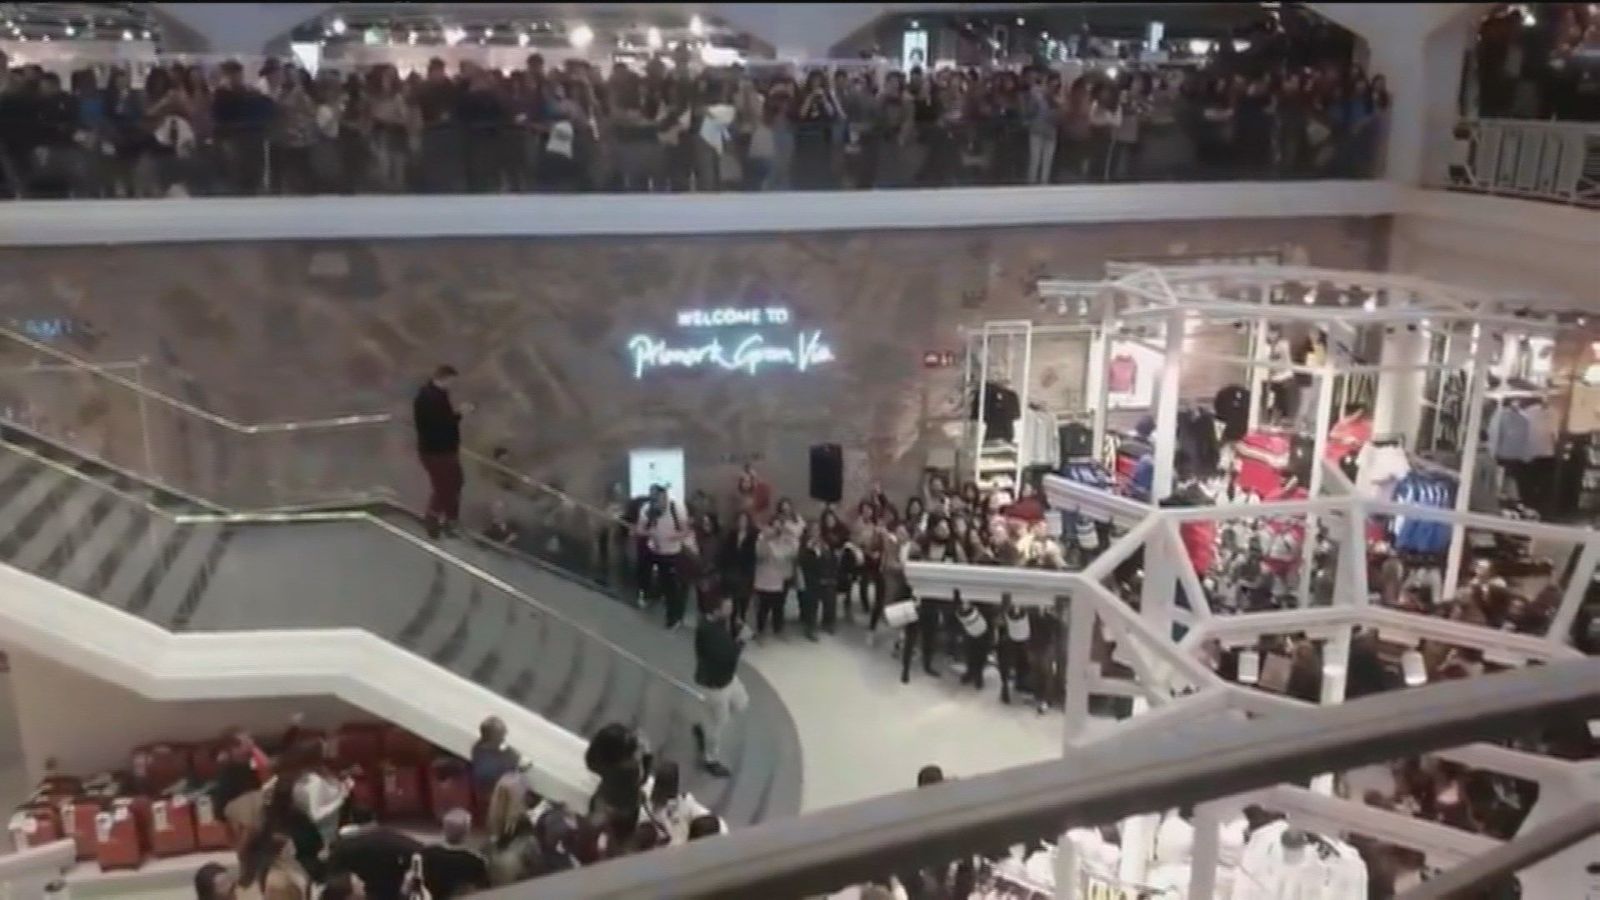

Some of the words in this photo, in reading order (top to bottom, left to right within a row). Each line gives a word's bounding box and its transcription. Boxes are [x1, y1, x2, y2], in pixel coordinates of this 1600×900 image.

[676, 309, 762, 327] WELCOME
[764, 307, 790, 325] TO
[628, 333, 724, 379] Primark
[728, 333, 796, 376] Gran
[798, 329, 836, 373] Via
